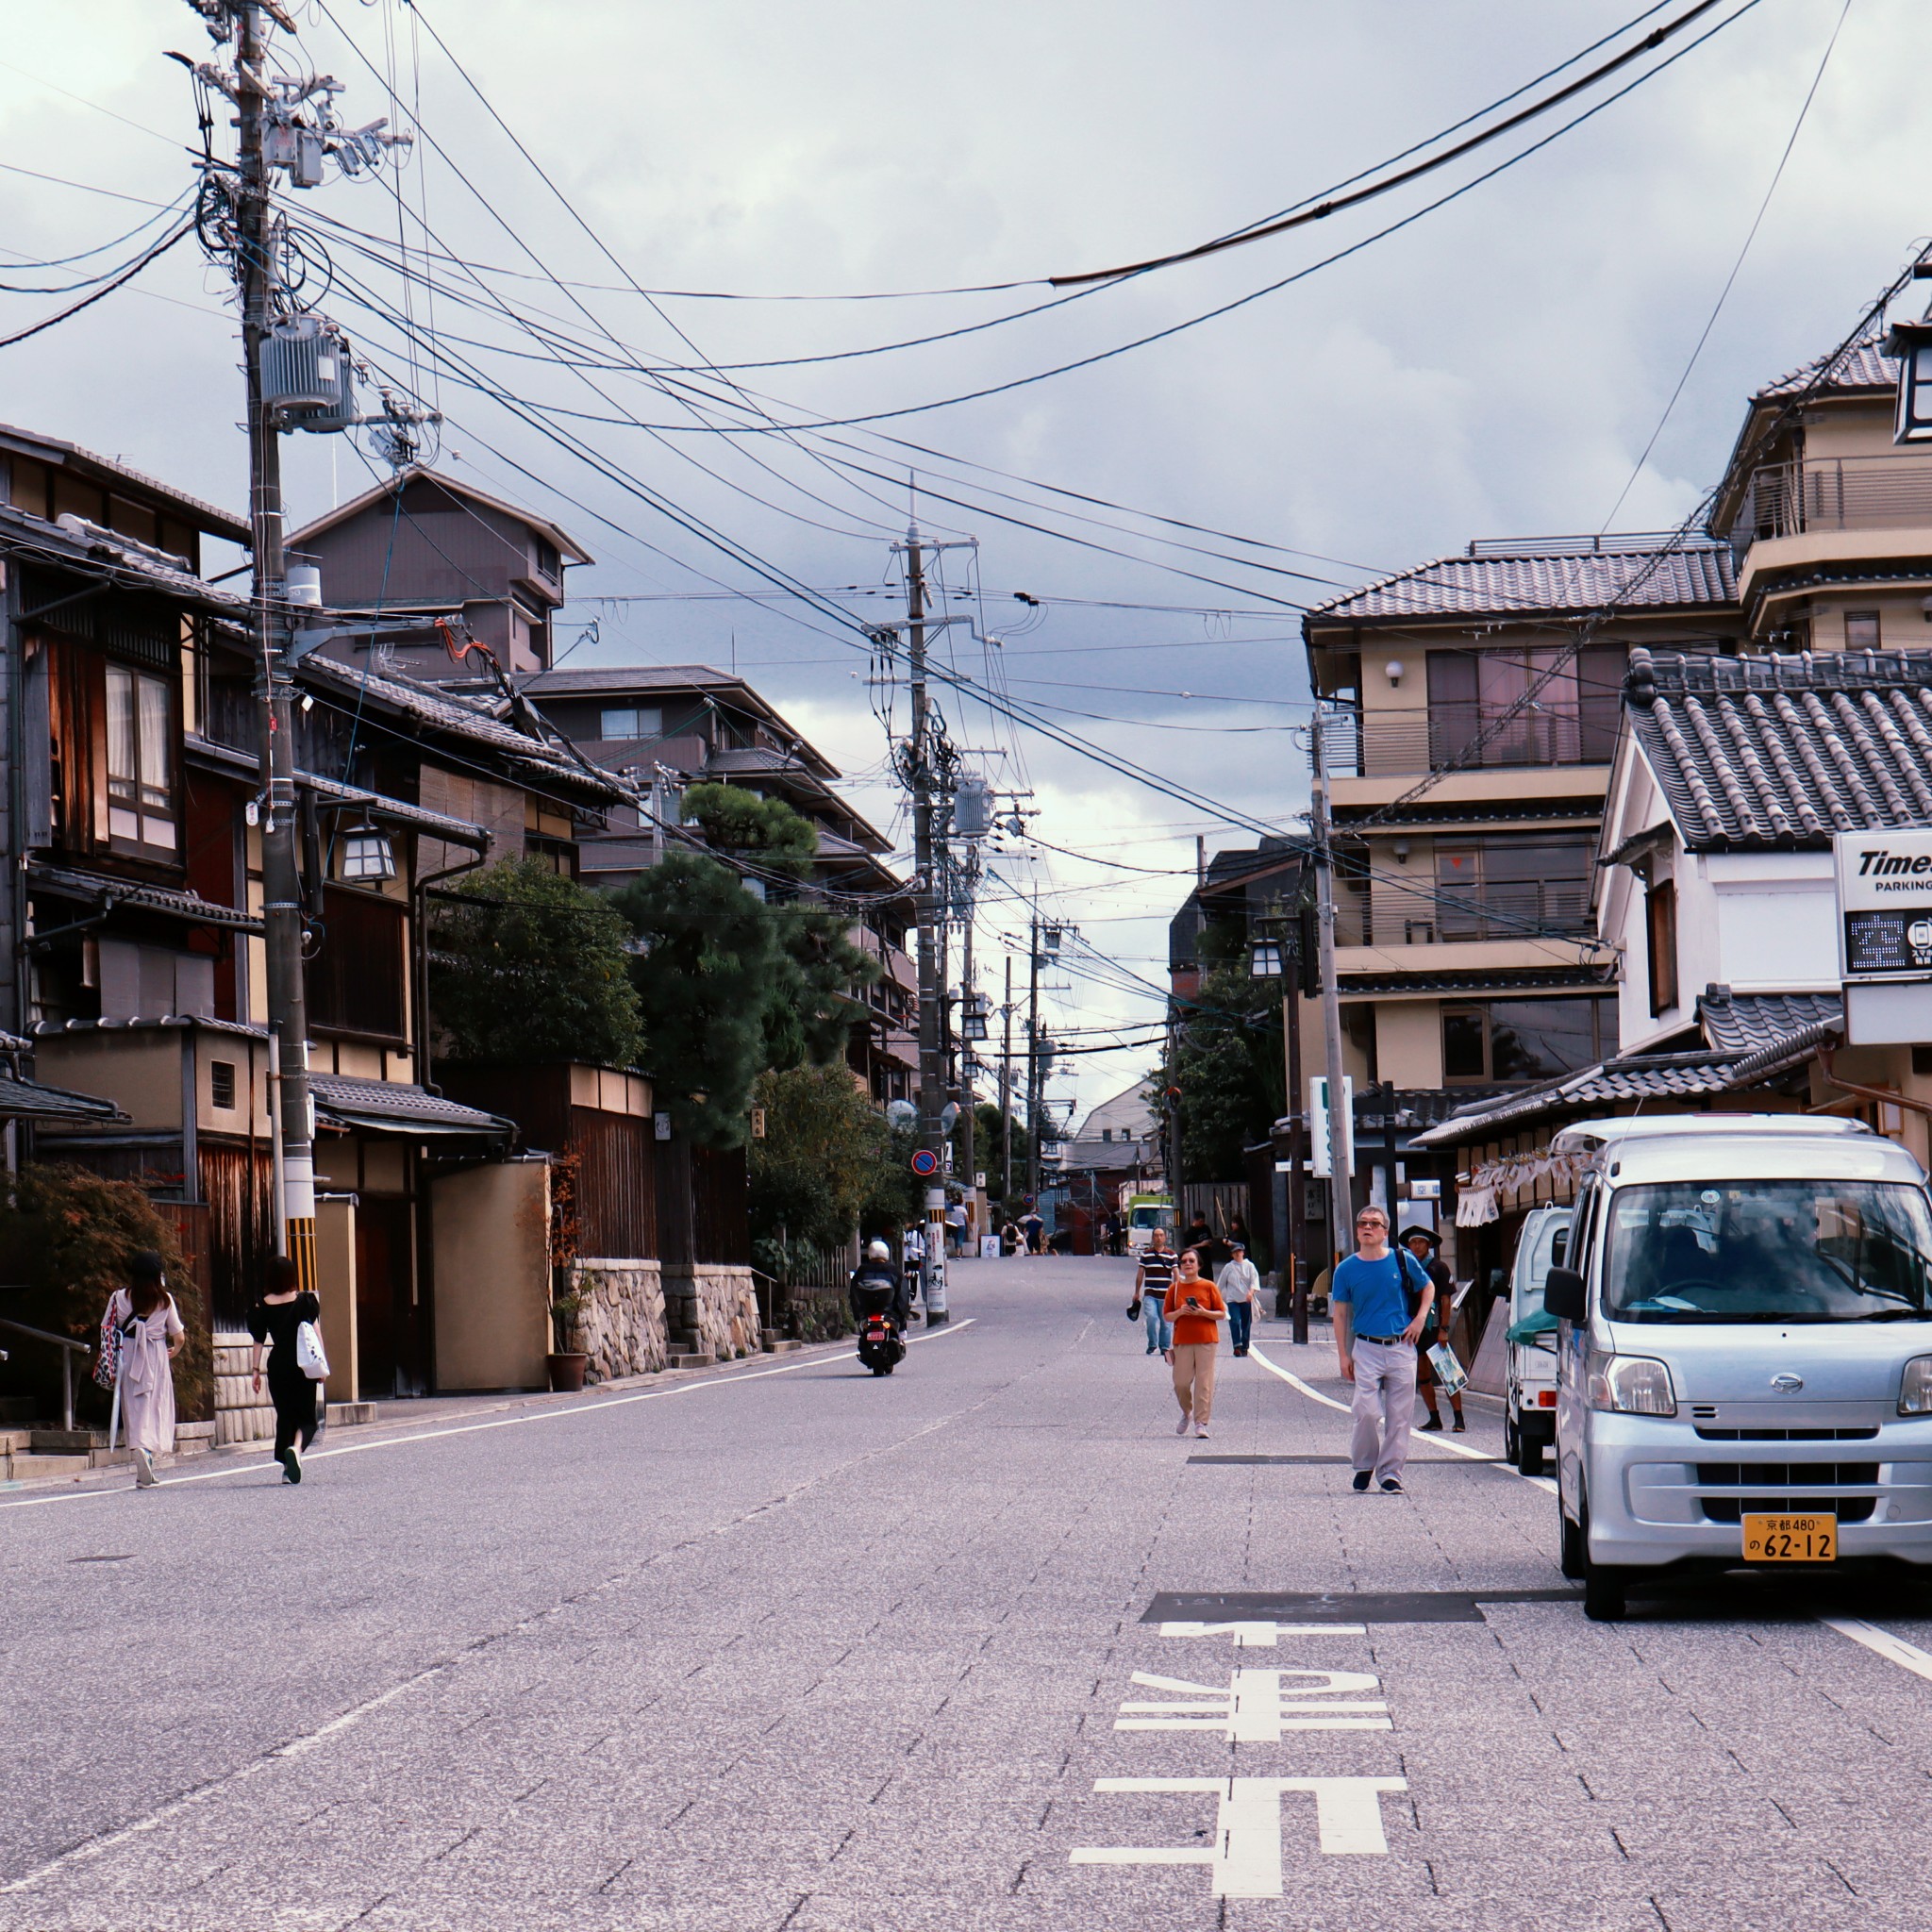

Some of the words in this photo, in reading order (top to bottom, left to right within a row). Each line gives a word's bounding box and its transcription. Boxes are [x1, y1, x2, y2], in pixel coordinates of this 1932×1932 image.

[1858, 851, 1932, 875] Time
[1875, 880, 1932, 892] PARKING
[1851, 914, 1906, 969] 空
[1749, 1540, 1760, 1551] の
[1764, 1534, 1831, 1557] 62-12
